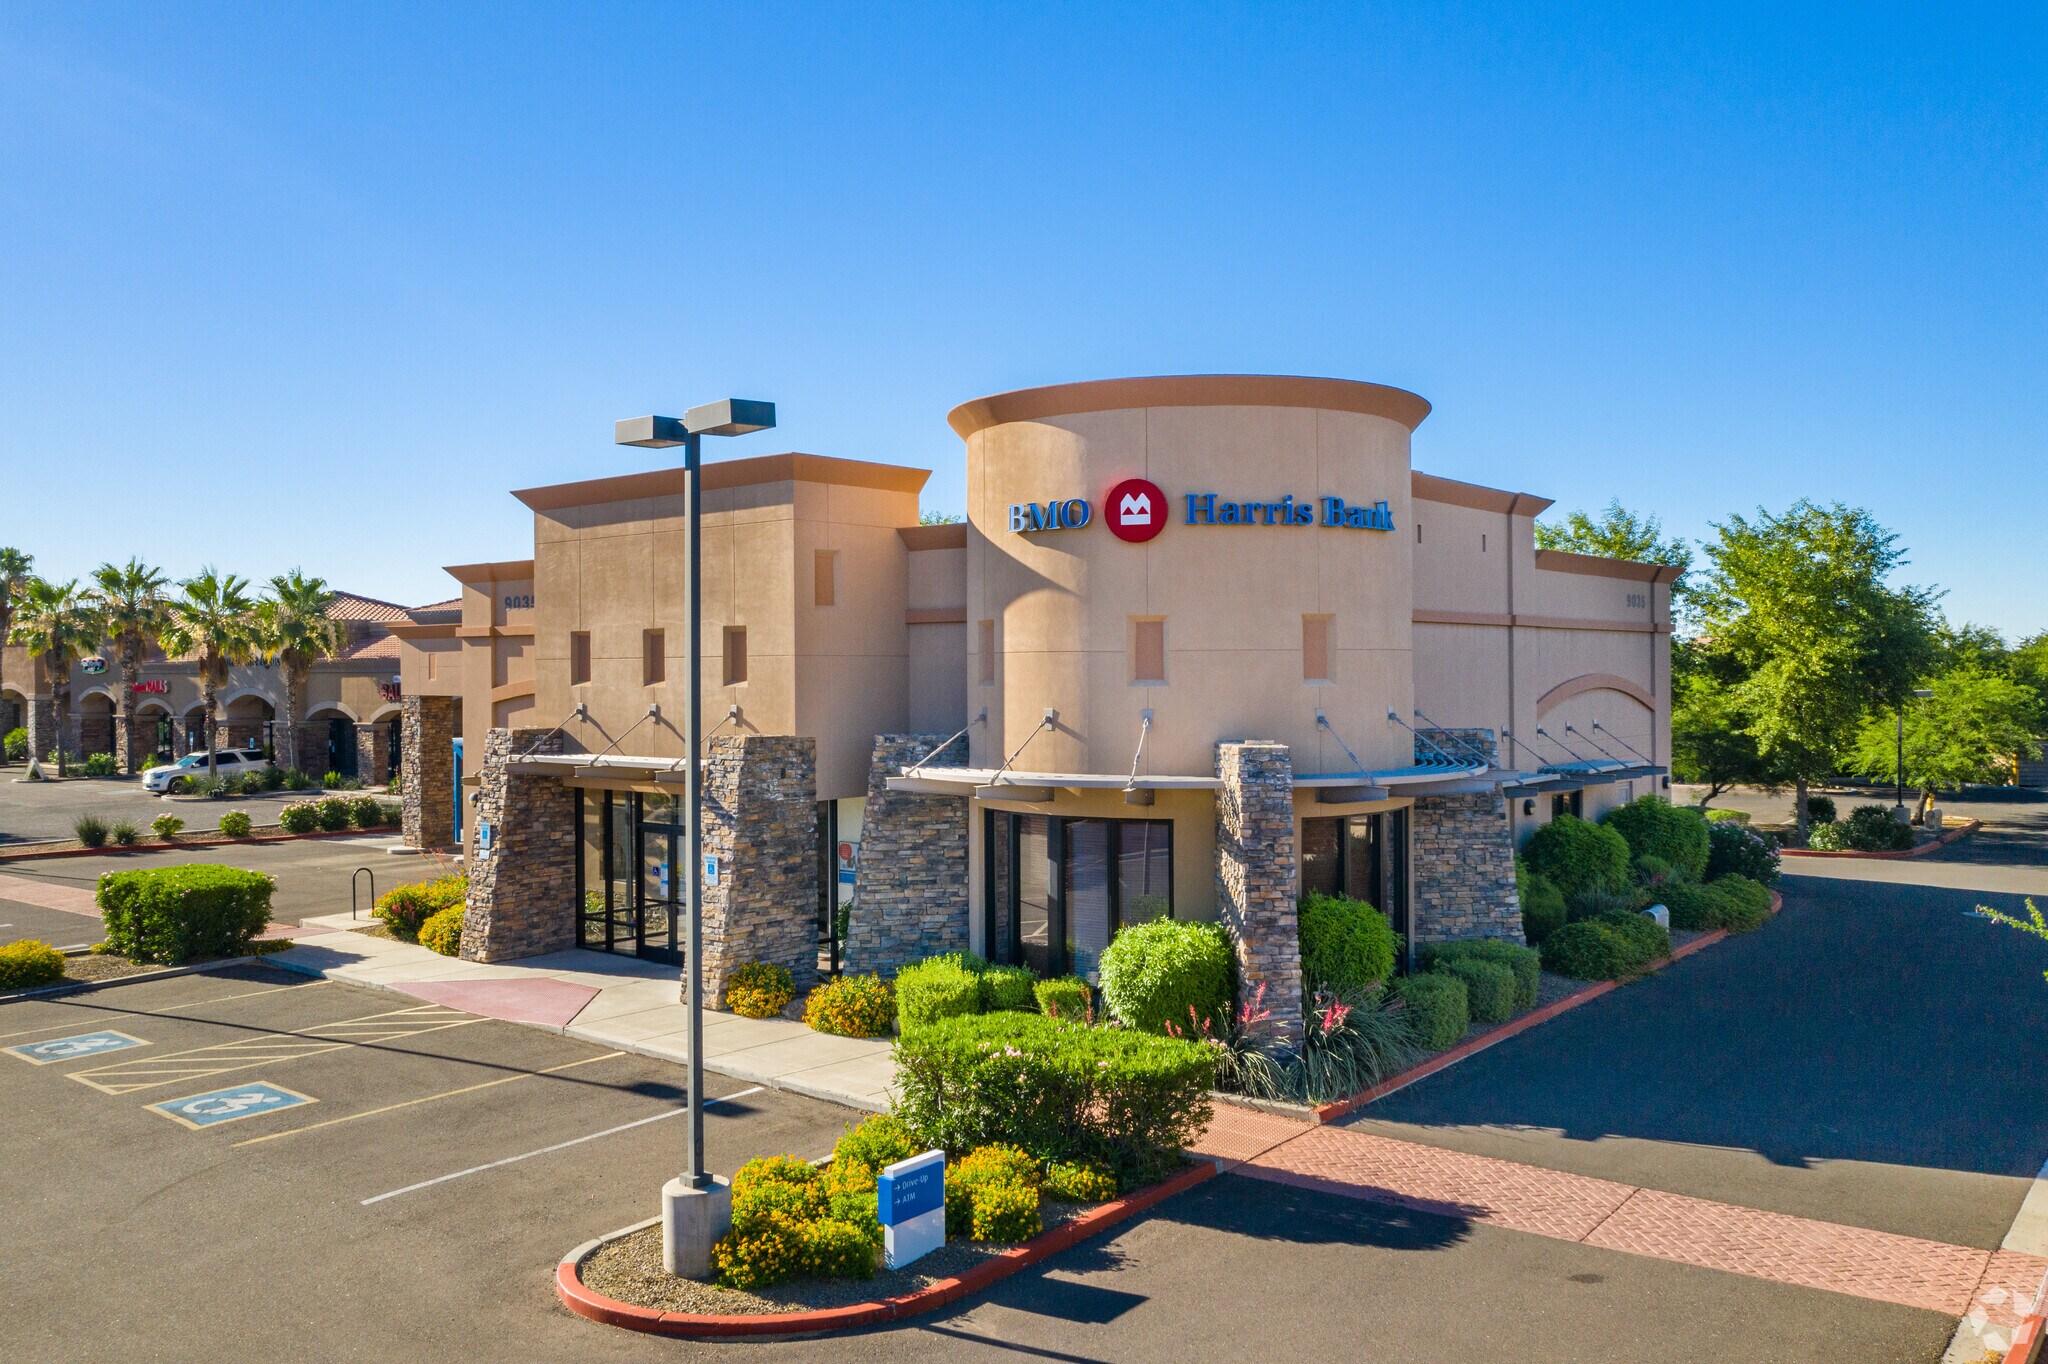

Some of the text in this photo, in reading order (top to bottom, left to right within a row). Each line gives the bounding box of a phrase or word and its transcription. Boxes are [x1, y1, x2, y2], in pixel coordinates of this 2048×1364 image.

[1008, 493, 1396, 533] BMO Harris Bank
[1626, 594, 1646, 609] 9035
[902, 1174, 929, 1190] Drive-Up
[902, 1192, 916, 1204] ATM
